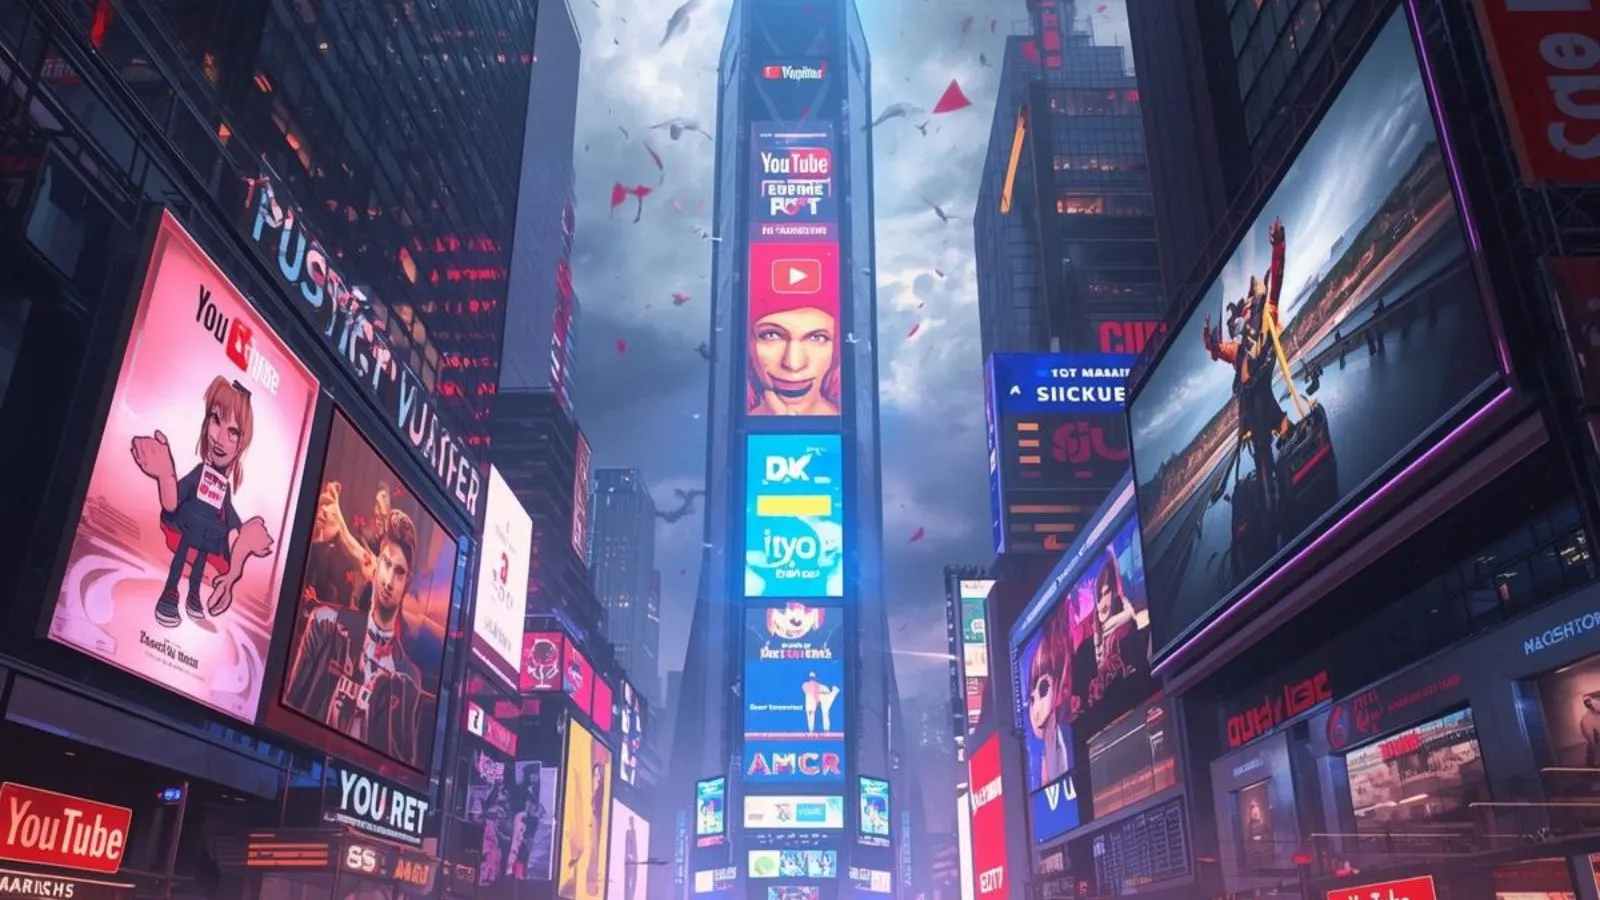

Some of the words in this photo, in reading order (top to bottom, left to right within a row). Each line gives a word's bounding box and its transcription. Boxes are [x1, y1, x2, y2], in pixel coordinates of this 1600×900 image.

[761, 151, 828, 173] YouTube
[6, 797, 123, 860] YouTube
[389, 790, 428, 834] RET
